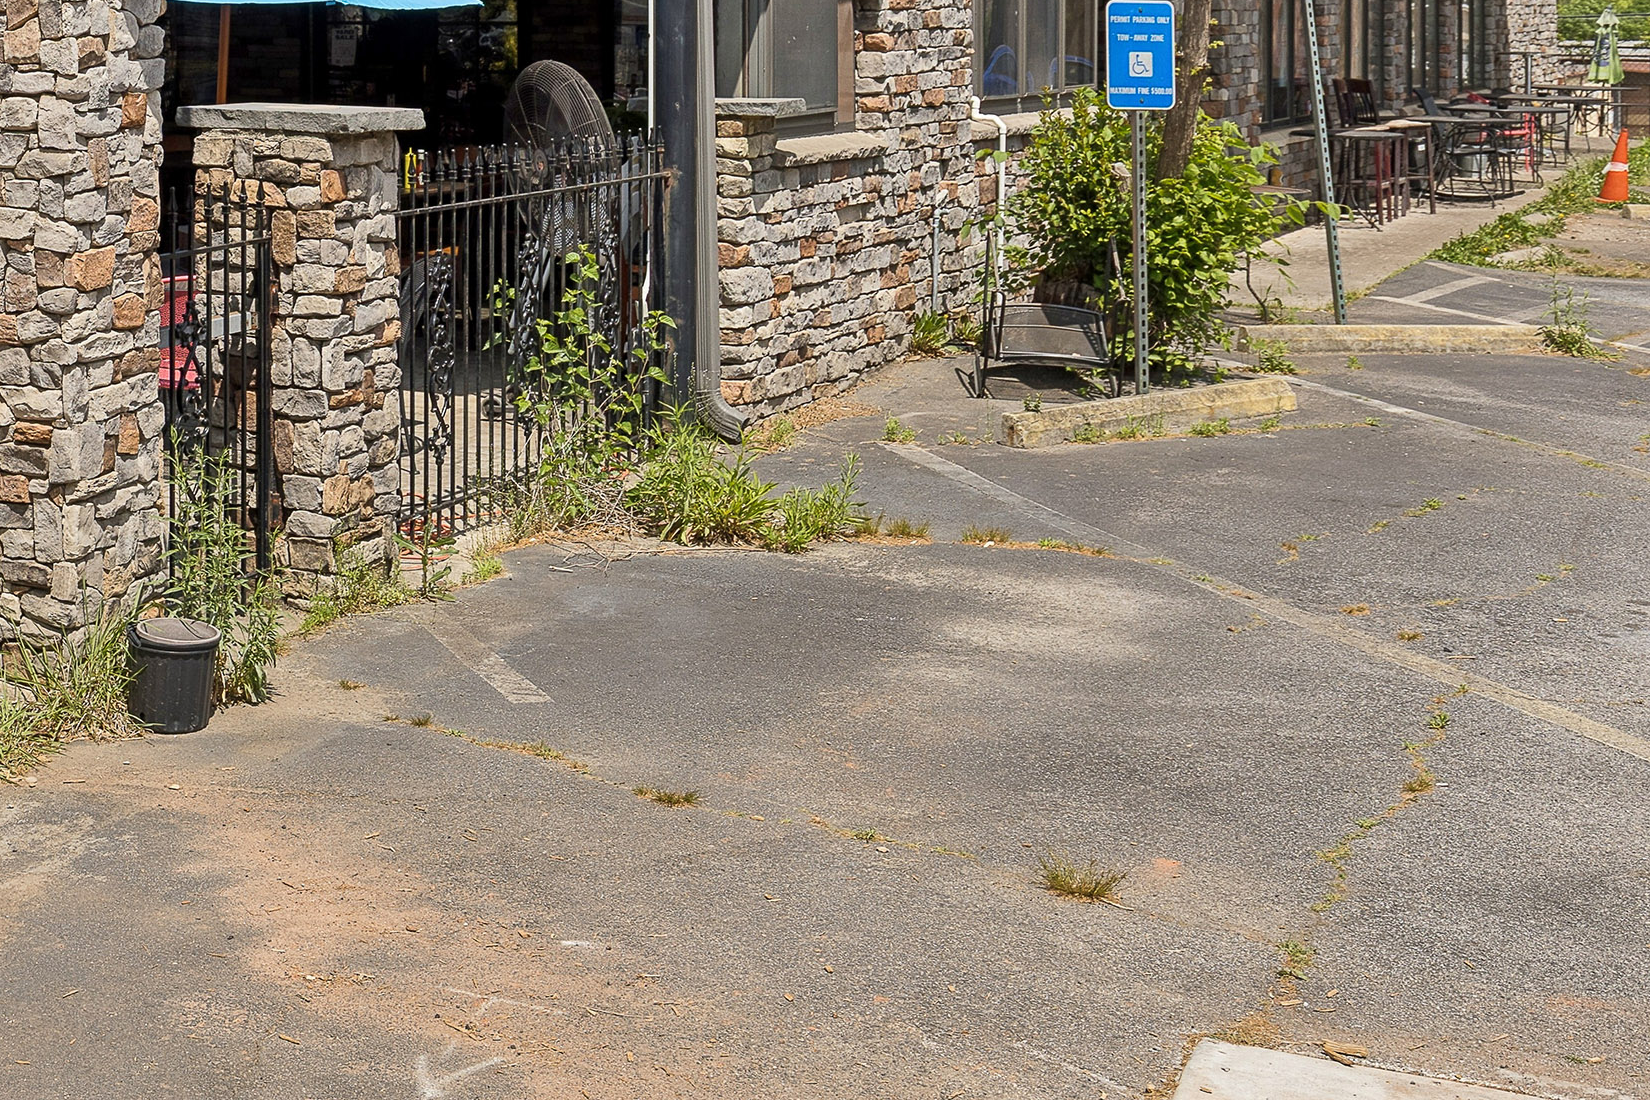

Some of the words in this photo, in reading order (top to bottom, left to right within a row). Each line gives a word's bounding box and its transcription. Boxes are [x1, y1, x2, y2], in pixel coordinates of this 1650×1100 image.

[1110, 15, 1130, 24] PERMIT
[1132, 15, 1155, 24] PARKING
[1157, 16, 1170, 24] ONLY
[1150, 34, 1165, 42] ZONE
[1109, 86, 1136, 95] MAXIMUM
[1137, 86, 1150, 95] FINE
